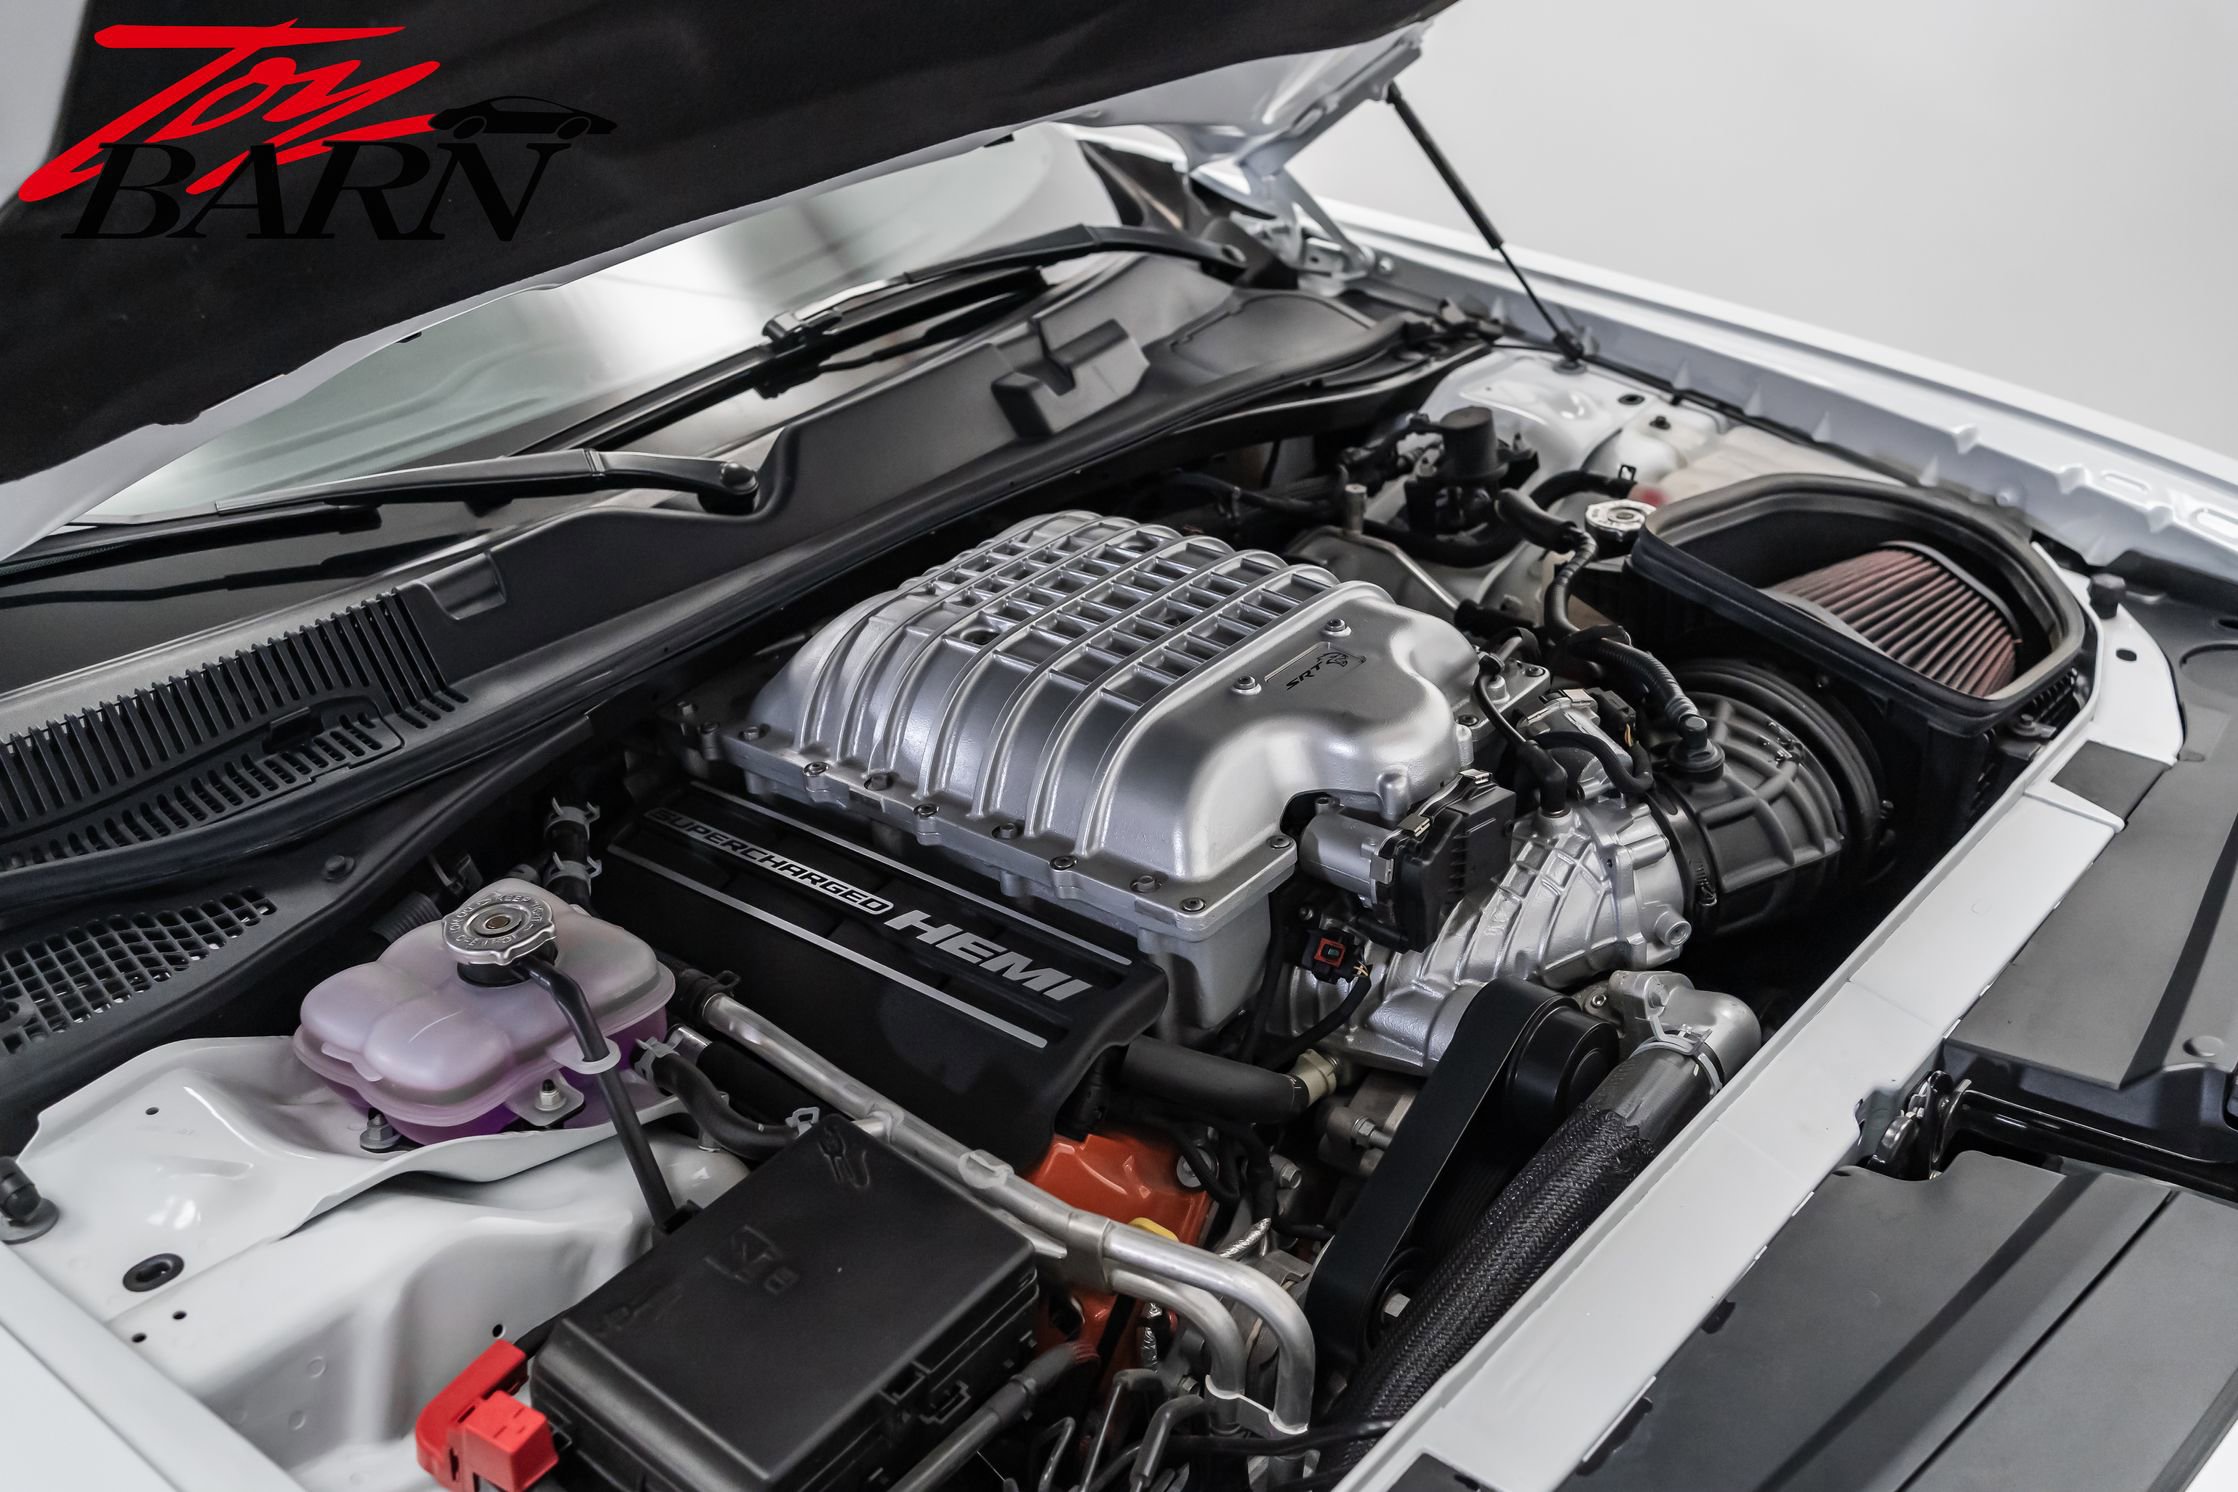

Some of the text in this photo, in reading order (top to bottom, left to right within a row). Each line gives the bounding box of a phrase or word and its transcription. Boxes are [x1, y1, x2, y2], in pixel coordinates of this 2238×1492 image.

[1285, 661, 1323, 690] SRT
[649, 811, 1095, 1001] SUPERCHARGED HEMI
